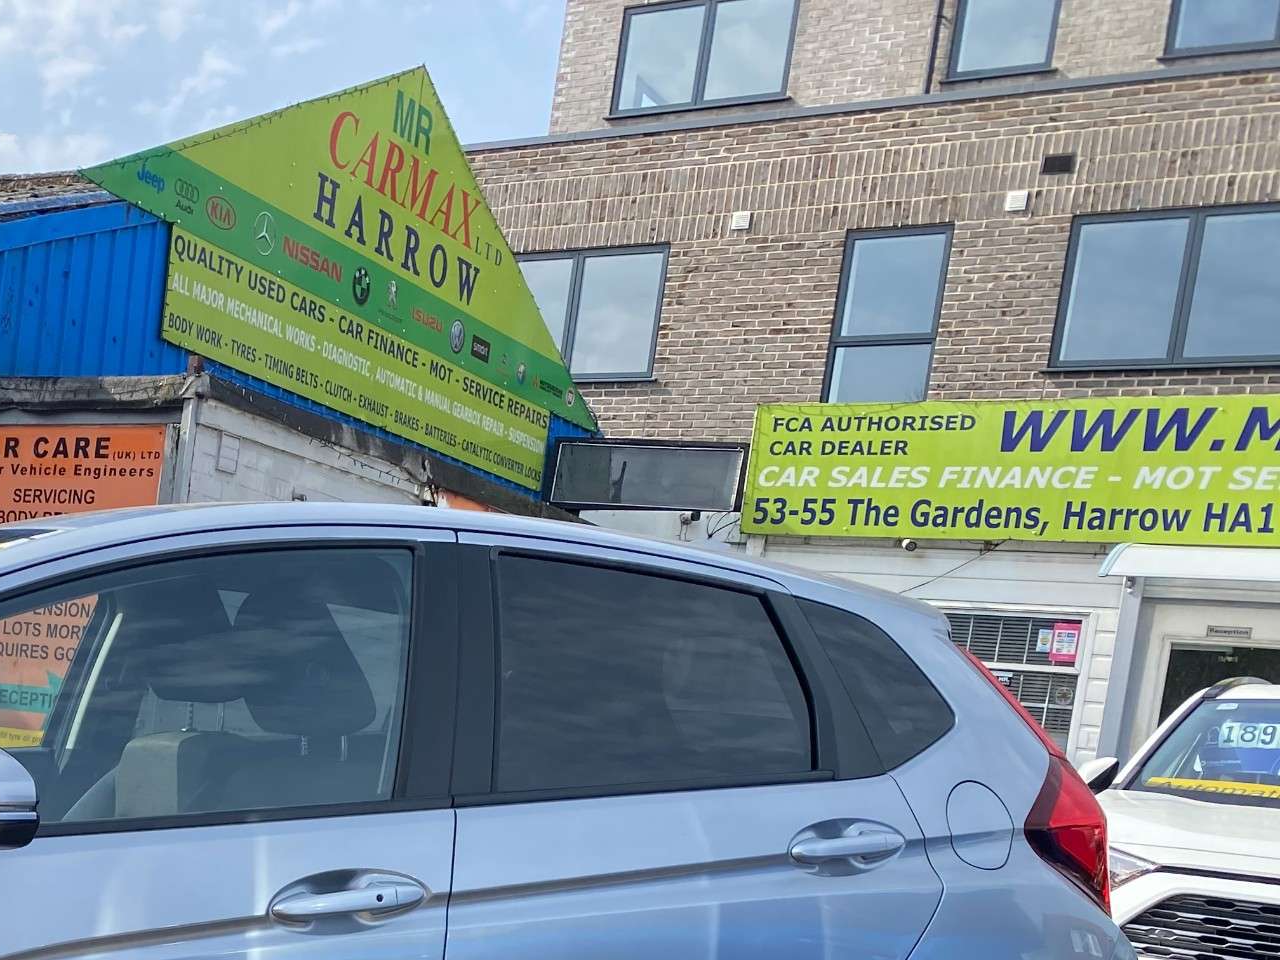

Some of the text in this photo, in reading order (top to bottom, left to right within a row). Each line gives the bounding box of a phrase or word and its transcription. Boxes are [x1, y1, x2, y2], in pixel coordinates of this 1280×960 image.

[393, 89, 433, 156] MR
[137, 160, 166, 194] Jeep
[329, 111, 480, 249] CARMAX
[313, 172, 480, 306] HARROW
[475, 236, 503, 266] LTD
[282, 236, 343, 283] NISSAN
[171, 271, 190, 297] ALL
[192, 280, 225, 313] MAJOR
[226, 297, 282, 342] MECHANICAL
[285, 323, 315, 353] WORKS
[322, 341, 370, 377] DIAGNOSTIC
[375, 366, 417, 398] AUTOMATIC
[424, 387, 451, 414] MANUAL
[451, 402, 481, 426] GEARBOX
[174, 234, 244, 283] QUALITY
[248, 270, 286, 303] USED
[290, 291, 326, 323] CARS
[338, 315, 363, 342] CAR
[367, 329, 419, 368] FINANCE
[429, 359, 454, 384] MOT
[462, 376, 505, 409] SERVICE
[506, 398, 548, 429] REPAIRS
[168, 312, 194, 336] BODY
[196, 324, 222, 349] WORK
[231, 339, 257, 363] TYRES
[264, 353, 294, 379] TIMING
[295, 367, 318, 389] BELTS
[325, 380, 352, 403] CLUTCH
[358, 394, 389, 418] EXHAUST
[394, 409, 420, 432] BRAKES
[424, 423, 457, 448] BATTERIES
[462, 439, 492, 463] CATALYTIC
[493, 452, 524, 475] CONVERTER
[524, 465, 542, 482] LOCKS
[772, 415, 976, 432] FCA AUTHORISED
[1000, 406, 1280, 452] WWW.M
[33, 436, 110, 459] CARE
[112, 450, 136, 461] (UK)
[140, 451, 160, 460] LTD
[770, 440, 908, 456] CAR DEALER
[11, 463, 66, 476] Vehicle
[74, 464, 154, 480] Engineers
[758, 465, 821, 488] CAR
[827, 465, 930, 489] SALES
[939, 465, 1098, 489] FINANCE
[1132, 465, 1223, 490] MOT
[1228, 466, 1280, 490] SE
[13, 488, 96, 505] SERVICING
[752, 497, 1274, 536] 53-55 The Gardens, Harrow HA1
[3, 621, 41, 637] LOTS
[46, 623, 86, 640] MOR
